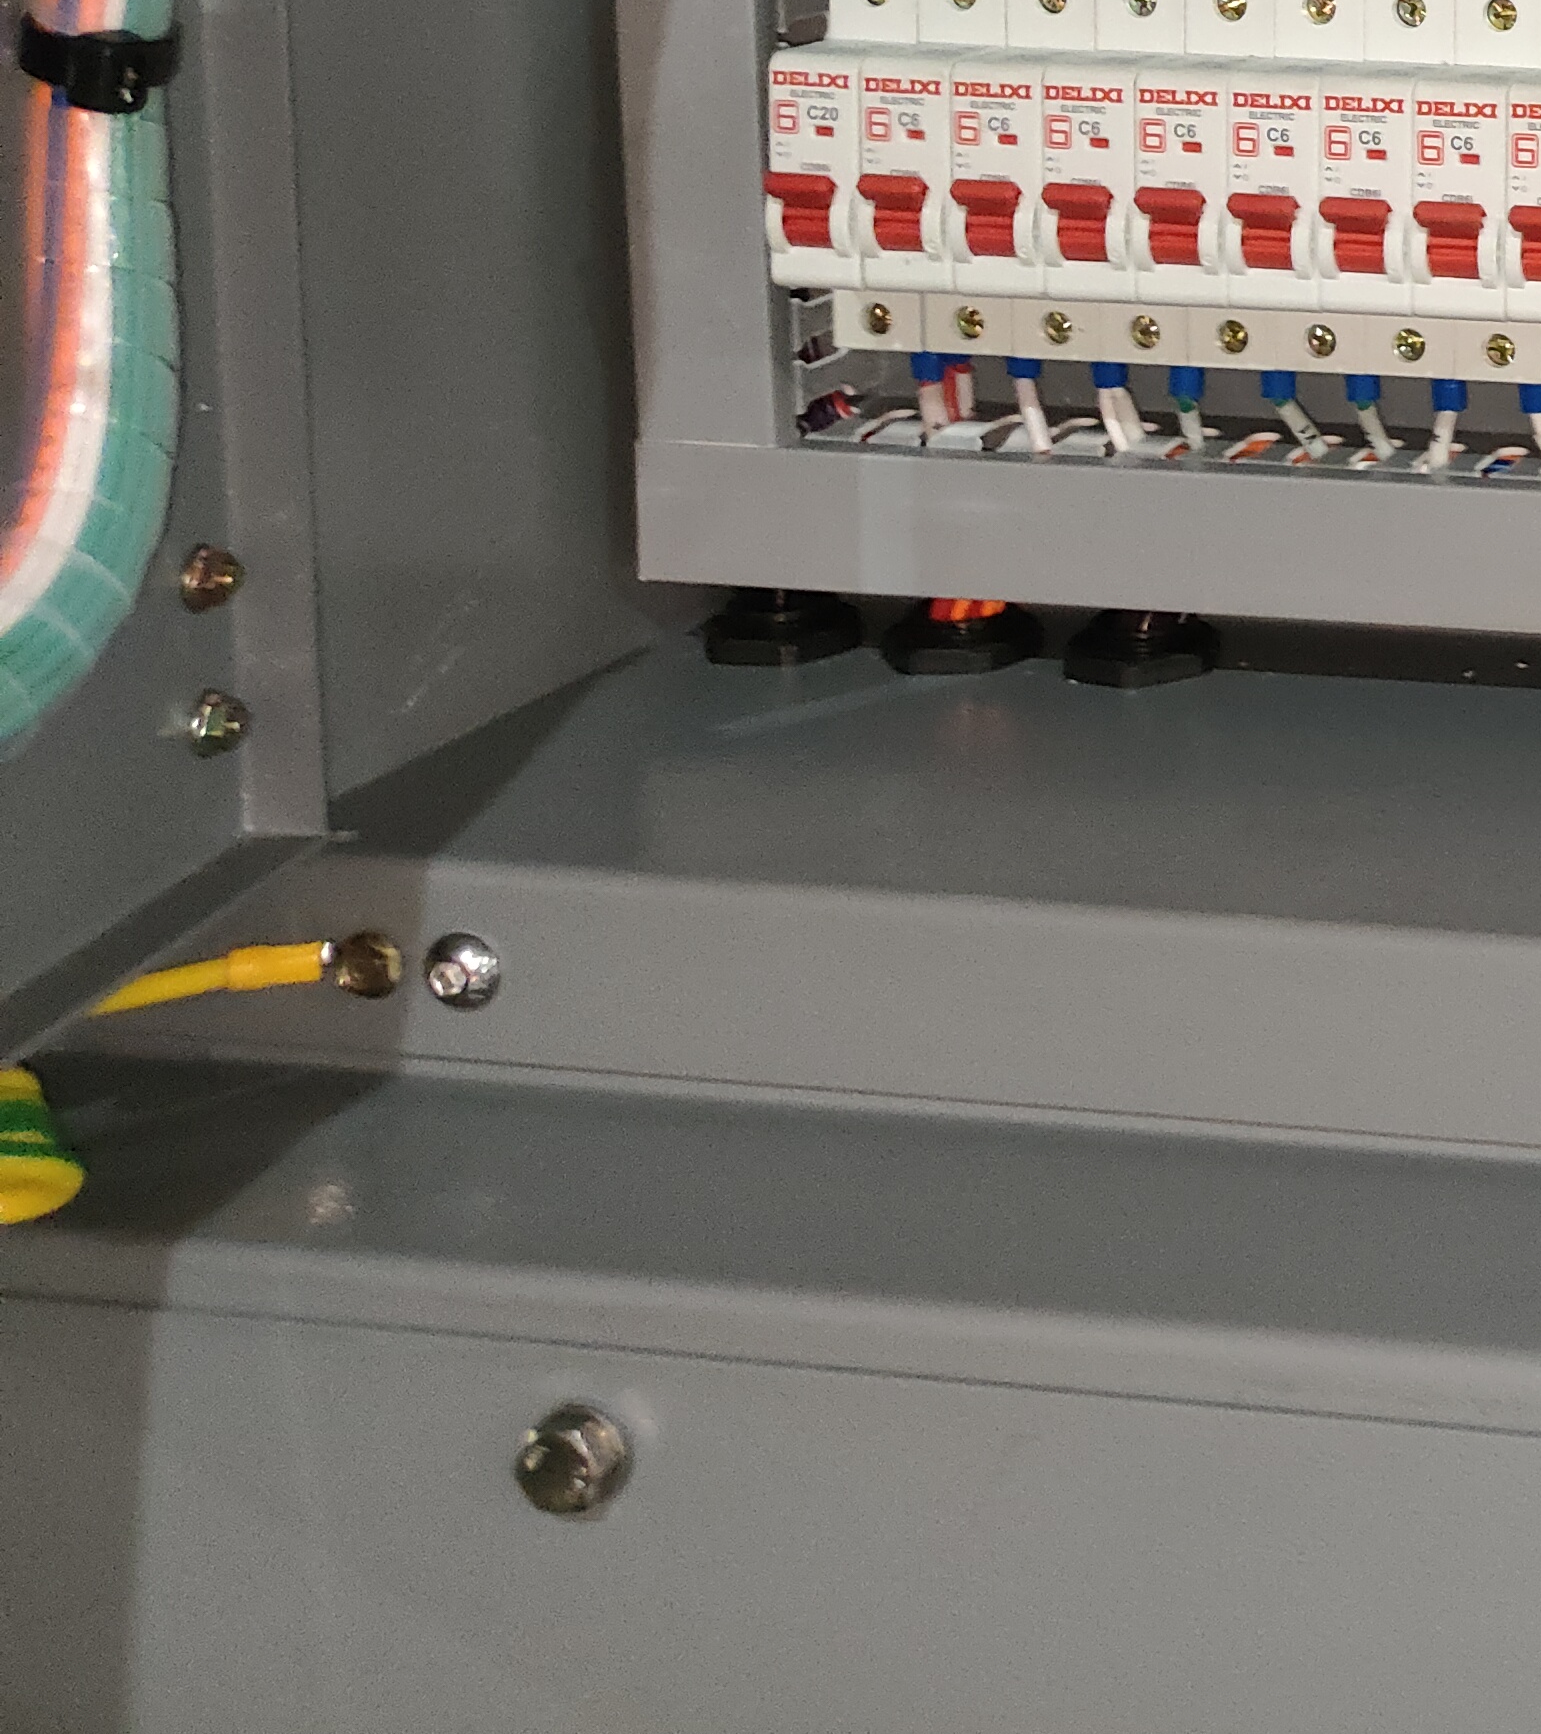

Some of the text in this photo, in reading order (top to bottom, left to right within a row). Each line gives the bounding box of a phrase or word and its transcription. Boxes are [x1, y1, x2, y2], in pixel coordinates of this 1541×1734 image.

[772, 70, 850, 89] DELIXI
[864, 77, 941, 95] DELIXI
[954, 82, 1032, 99] DELIXI
[1044, 85, 1123, 103] DELIXI
[1139, 89, 1218, 106] DELIXI
[1233, 92, 1312, 110] DELIXI
[1324, 96, 1404, 114] DELIXI
[774, 101, 838, 133] 6 C20
[1416, 101, 1497, 119] DELIXI
[866, 107, 891, 141] 6
[955, 111, 1010, 145] 6 C6
[1046, 115, 1101, 149] 6 C6
[1140, 118, 1197, 152] 6 C6
[1433, 119, 1480, 129] ELECTRIC
[1233, 123, 1290, 156] 6 C6
[1325, 126, 1382, 160] 6 C6
[1417, 131, 1474, 165] 6 C6
[1512, 133, 1539, 168] 6
